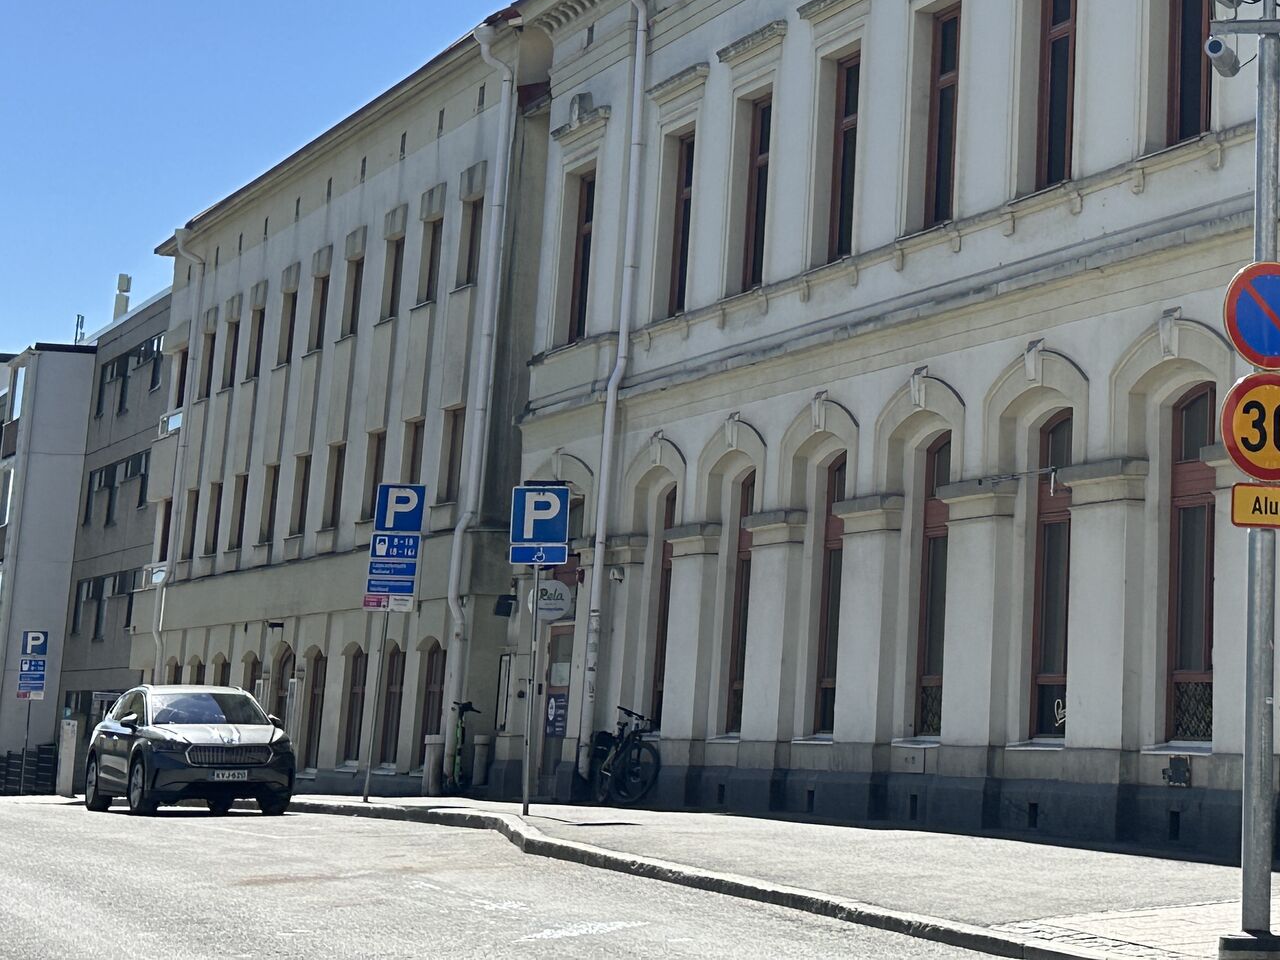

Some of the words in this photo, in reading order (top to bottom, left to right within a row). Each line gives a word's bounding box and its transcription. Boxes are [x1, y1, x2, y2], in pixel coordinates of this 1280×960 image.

[384, 487, 419, 529] P
[523, 492, 561, 539] P
[26, 632, 45, 654] P
